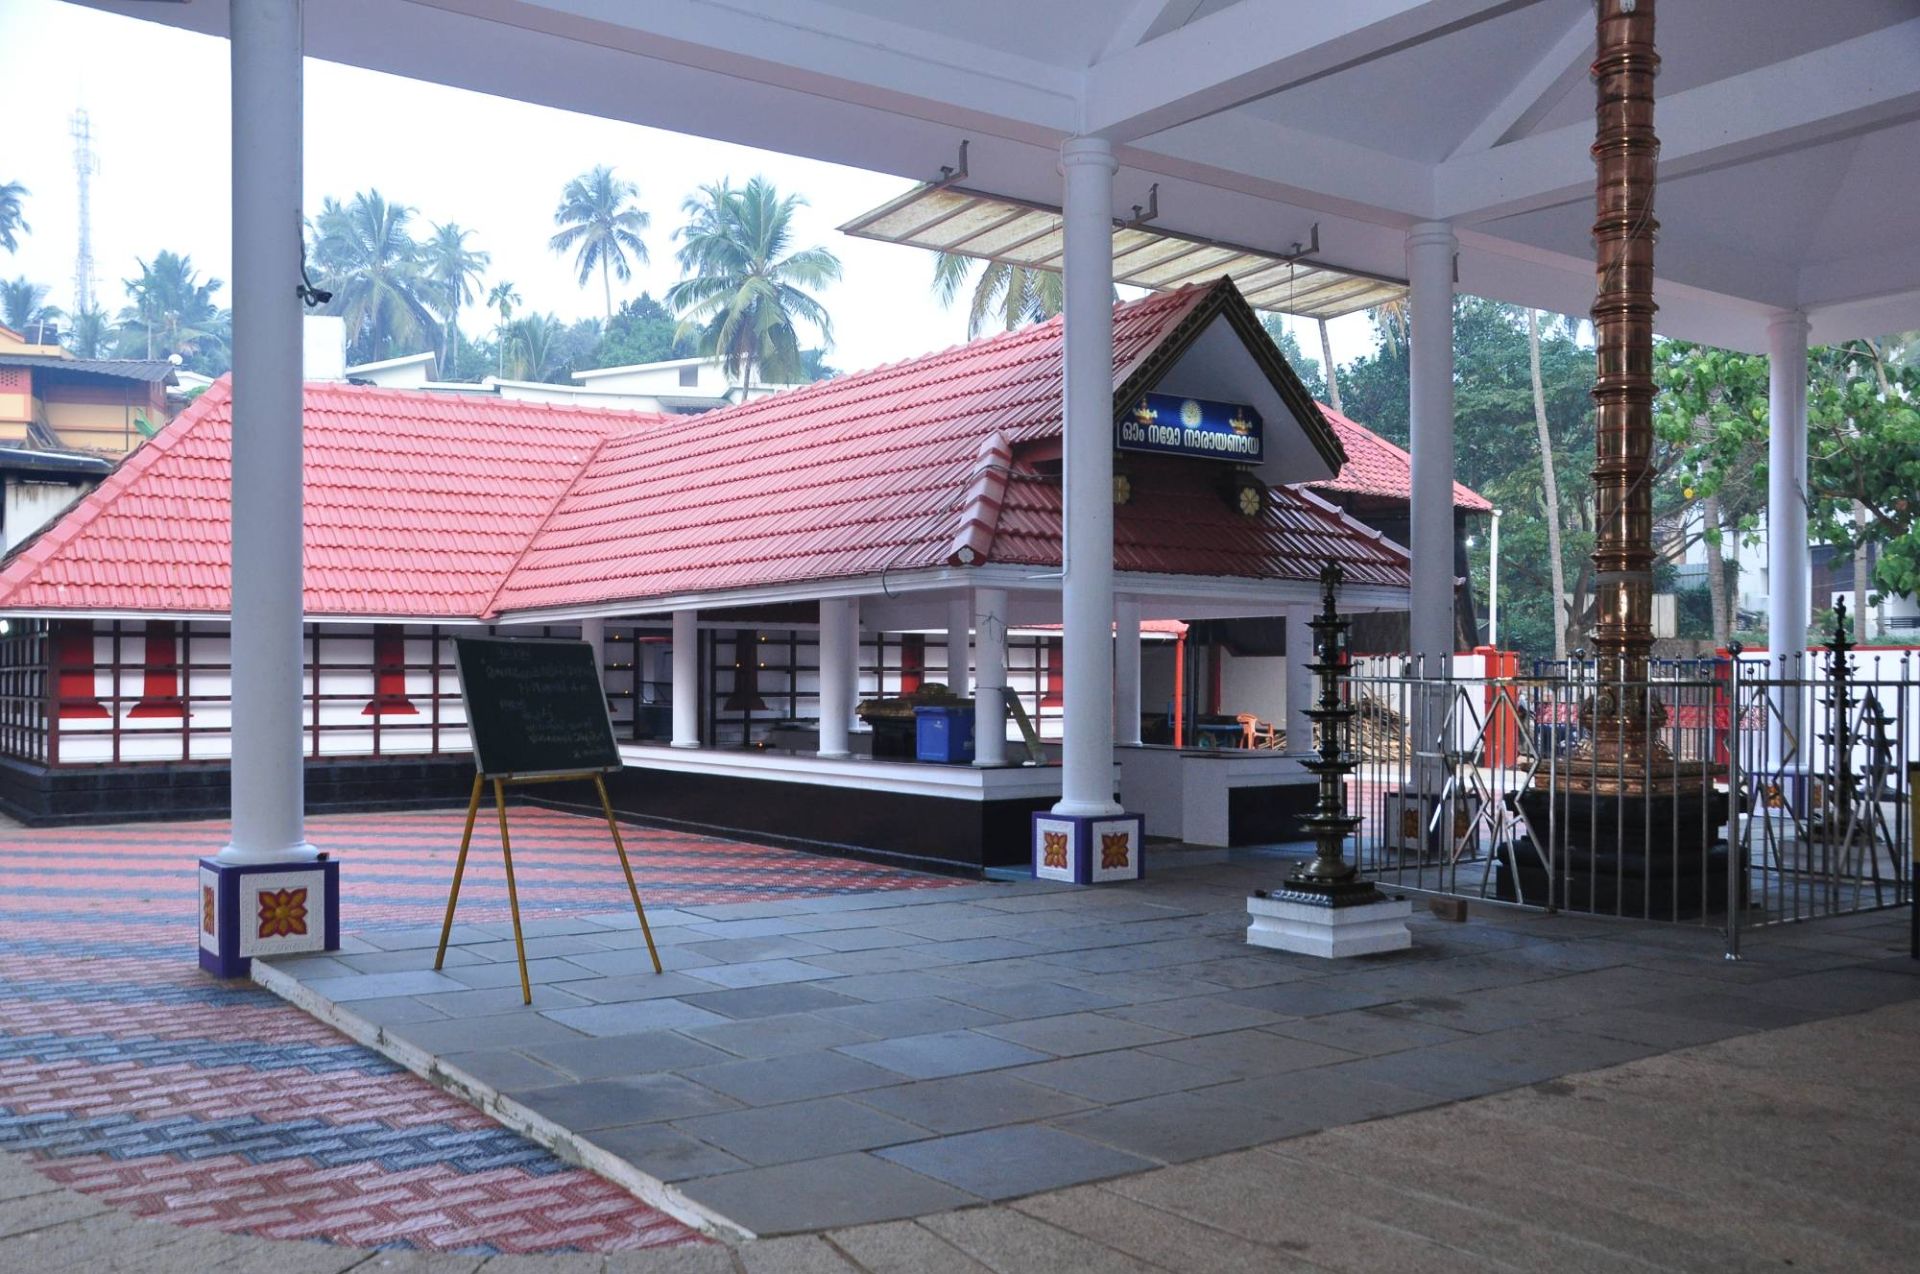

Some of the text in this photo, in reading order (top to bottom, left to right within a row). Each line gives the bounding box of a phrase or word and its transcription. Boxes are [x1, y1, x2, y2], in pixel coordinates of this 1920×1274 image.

[1122, 422, 1260, 454] ഓം നമോ നാരായണായ
